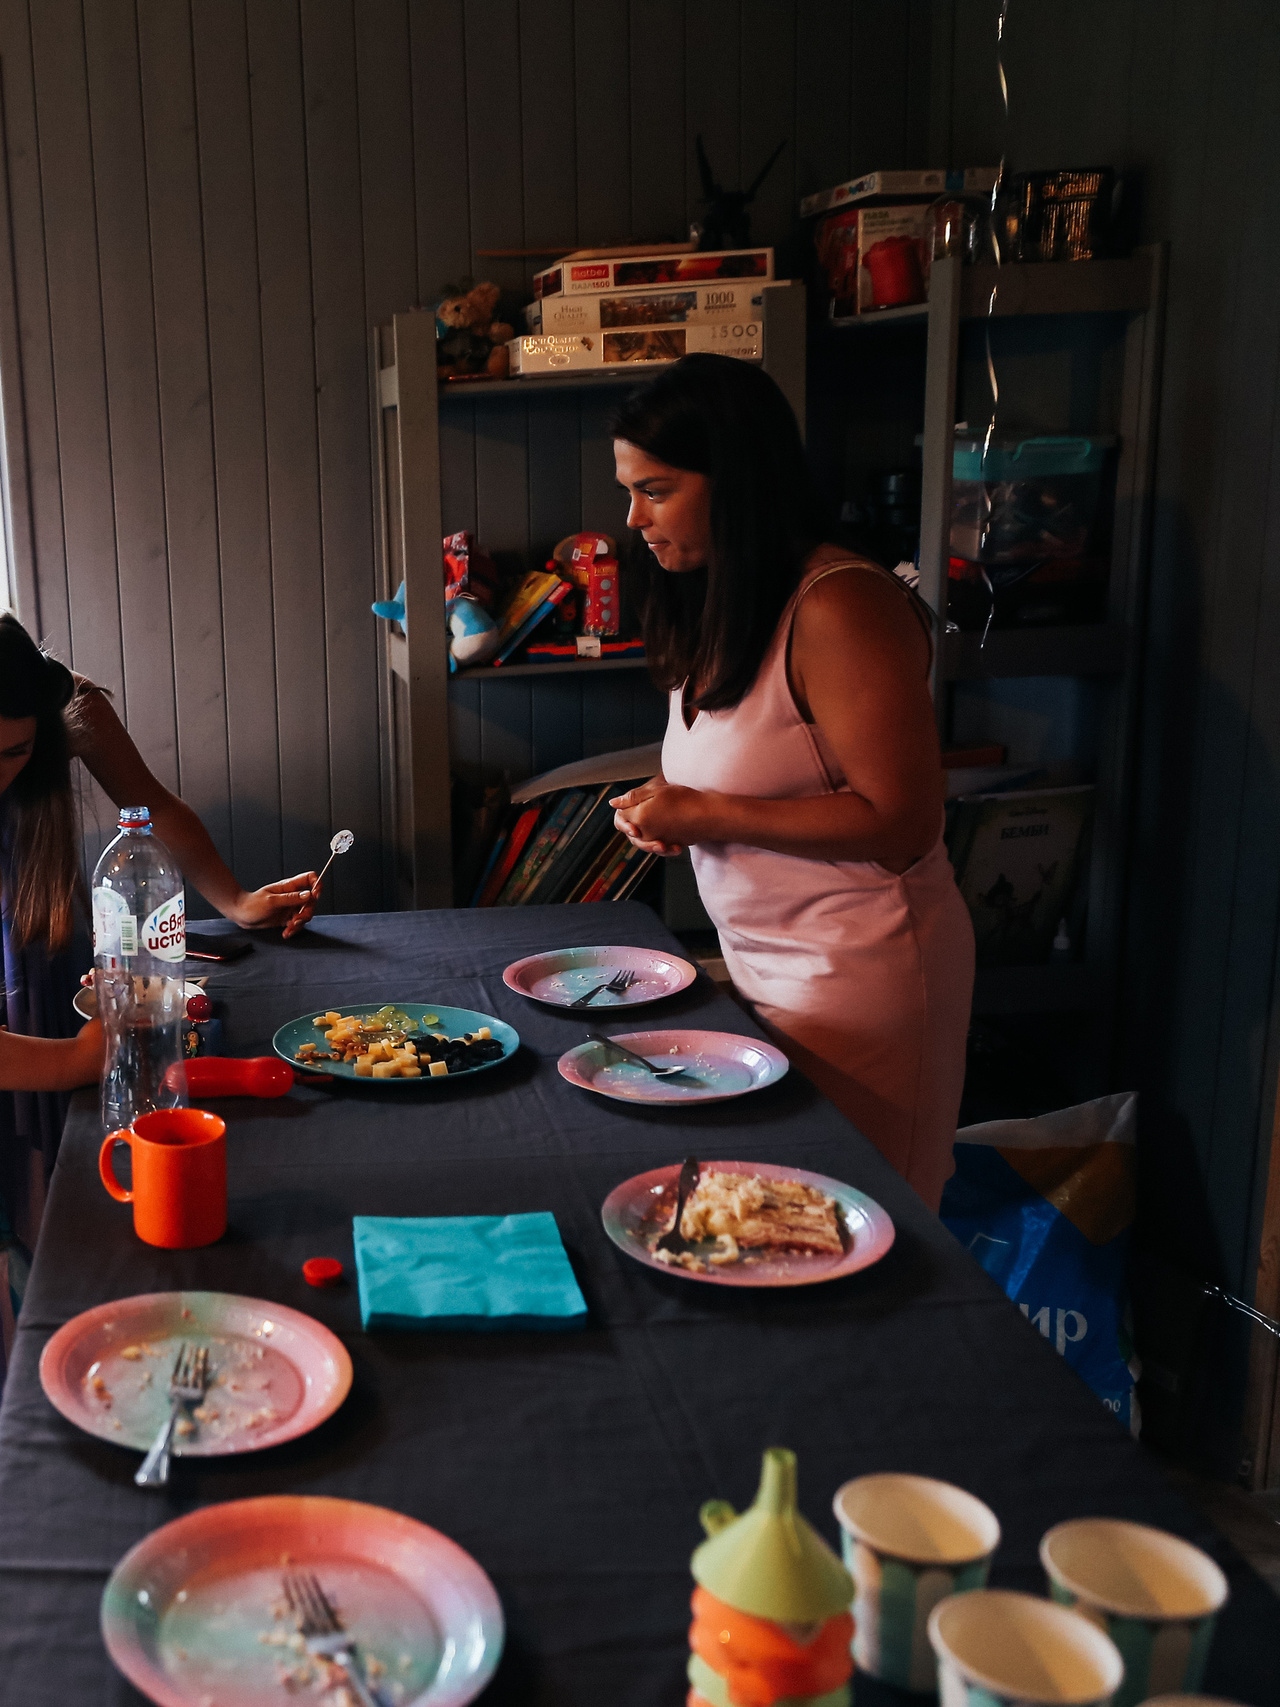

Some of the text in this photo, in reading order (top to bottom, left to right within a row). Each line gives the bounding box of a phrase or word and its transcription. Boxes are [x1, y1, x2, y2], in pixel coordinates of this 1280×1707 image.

[573, 268, 607, 278] hatber
[706, 291, 734, 305] 1000
[711, 324, 758, 339] 1500
[1001, 823, 1049, 840] БЕМБИ
